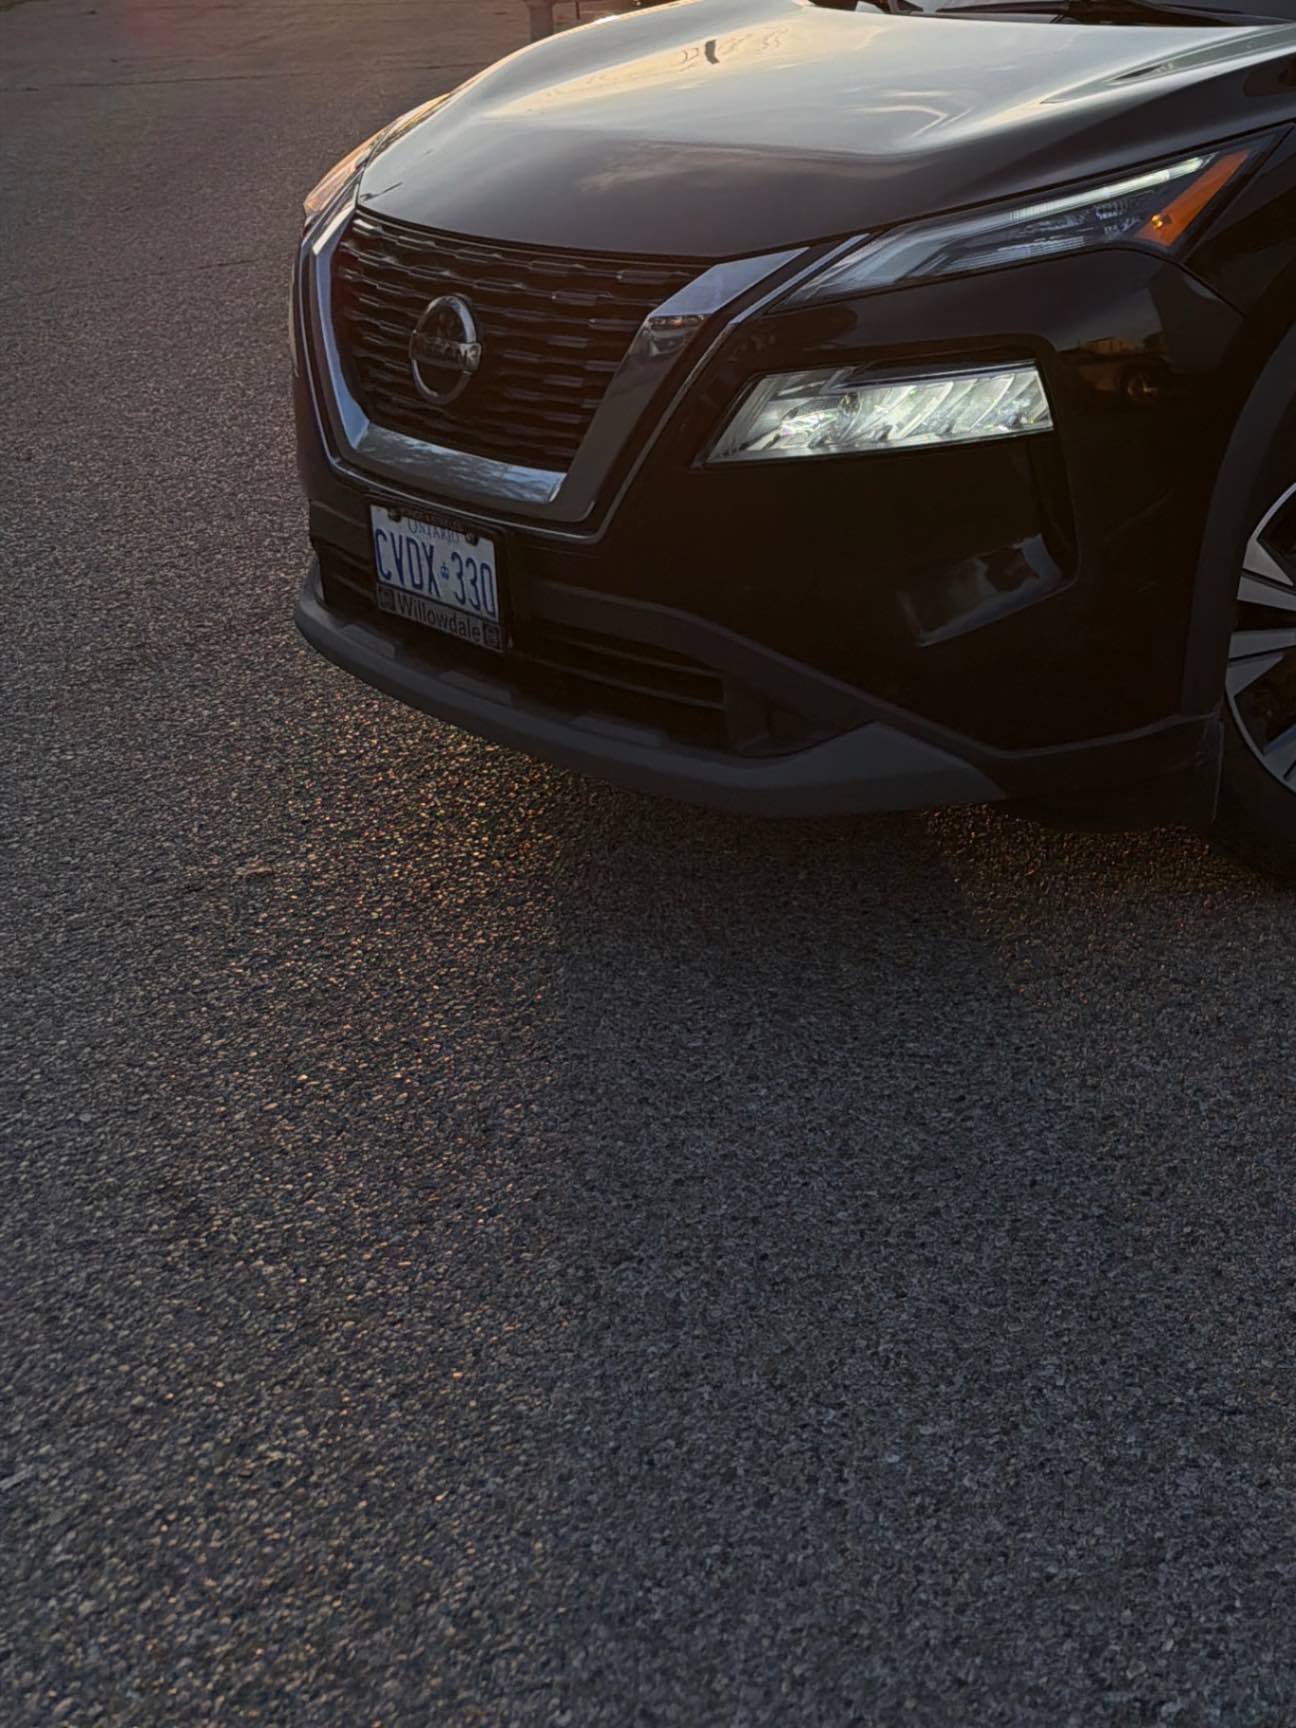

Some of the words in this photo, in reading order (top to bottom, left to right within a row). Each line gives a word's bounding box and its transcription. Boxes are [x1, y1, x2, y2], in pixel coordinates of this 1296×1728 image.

[374, 527, 440, 599] CVDX
[450, 551, 497, 618] 330
[397, 591, 481, 642] Willowdale
